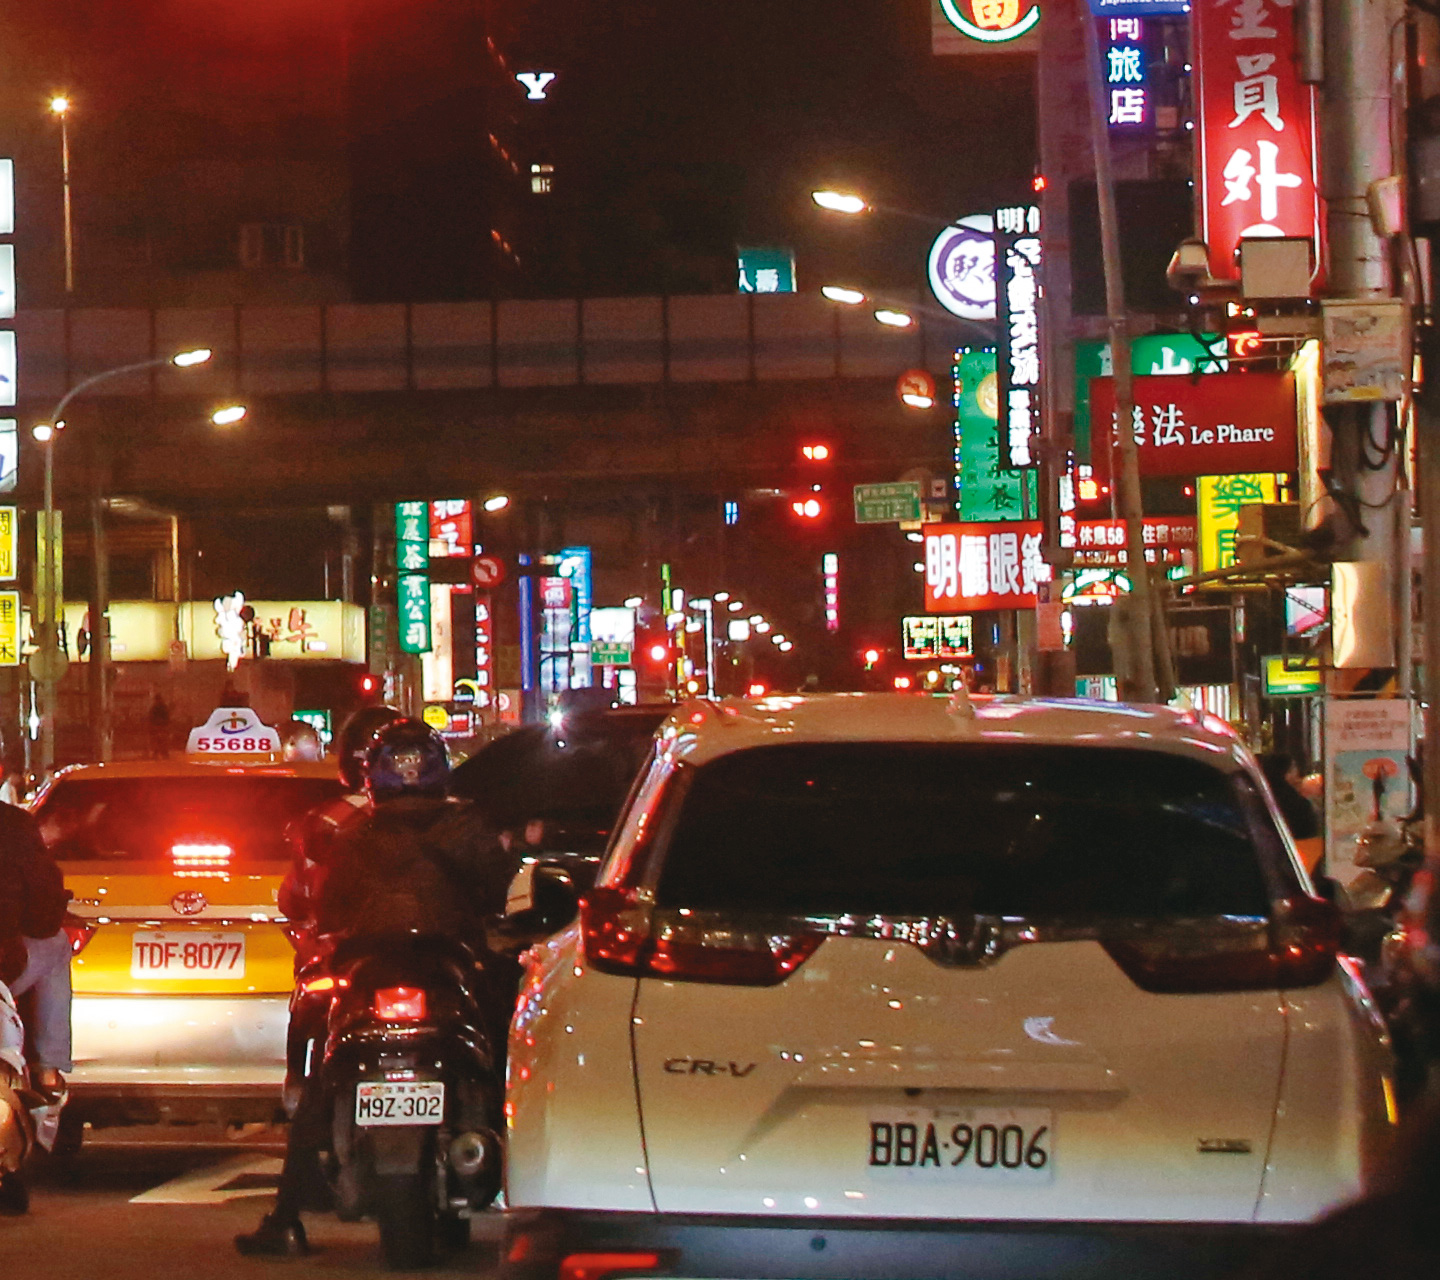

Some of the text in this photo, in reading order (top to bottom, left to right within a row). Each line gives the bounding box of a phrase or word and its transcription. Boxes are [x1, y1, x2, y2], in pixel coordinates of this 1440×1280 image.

[1191, 425, 1215, 444] Le
[1217, 423, 1274, 443] Phare
[197, 737, 272, 752] 55688
[664, 1057, 757, 1079] CR-V
